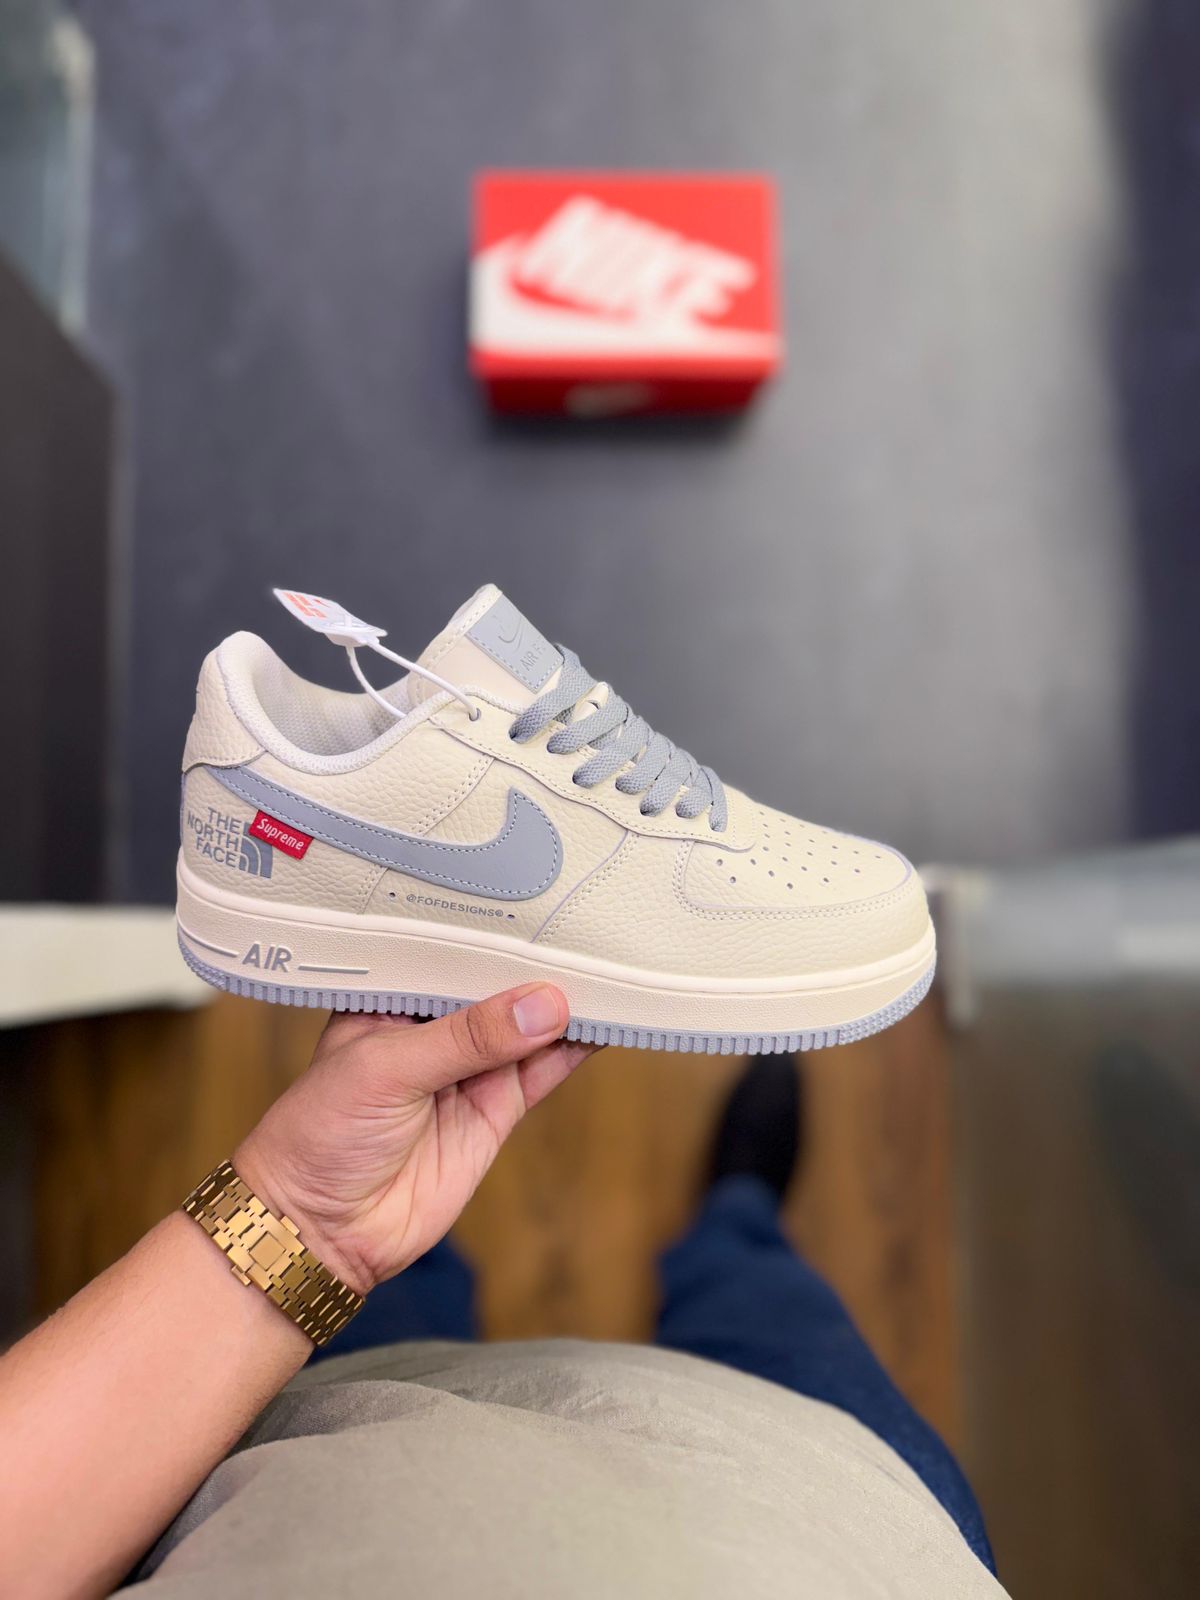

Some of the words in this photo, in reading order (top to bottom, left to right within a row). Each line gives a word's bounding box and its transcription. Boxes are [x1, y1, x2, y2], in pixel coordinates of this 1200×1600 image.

[520, 650, 539, 672] AIR
[187, 810, 239, 852] NORTH
[207, 806, 242, 836] THE
[256, 818, 305, 850] Supreme
[195, 835, 237, 868] FACE
[241, 942, 293, 973] AIR
